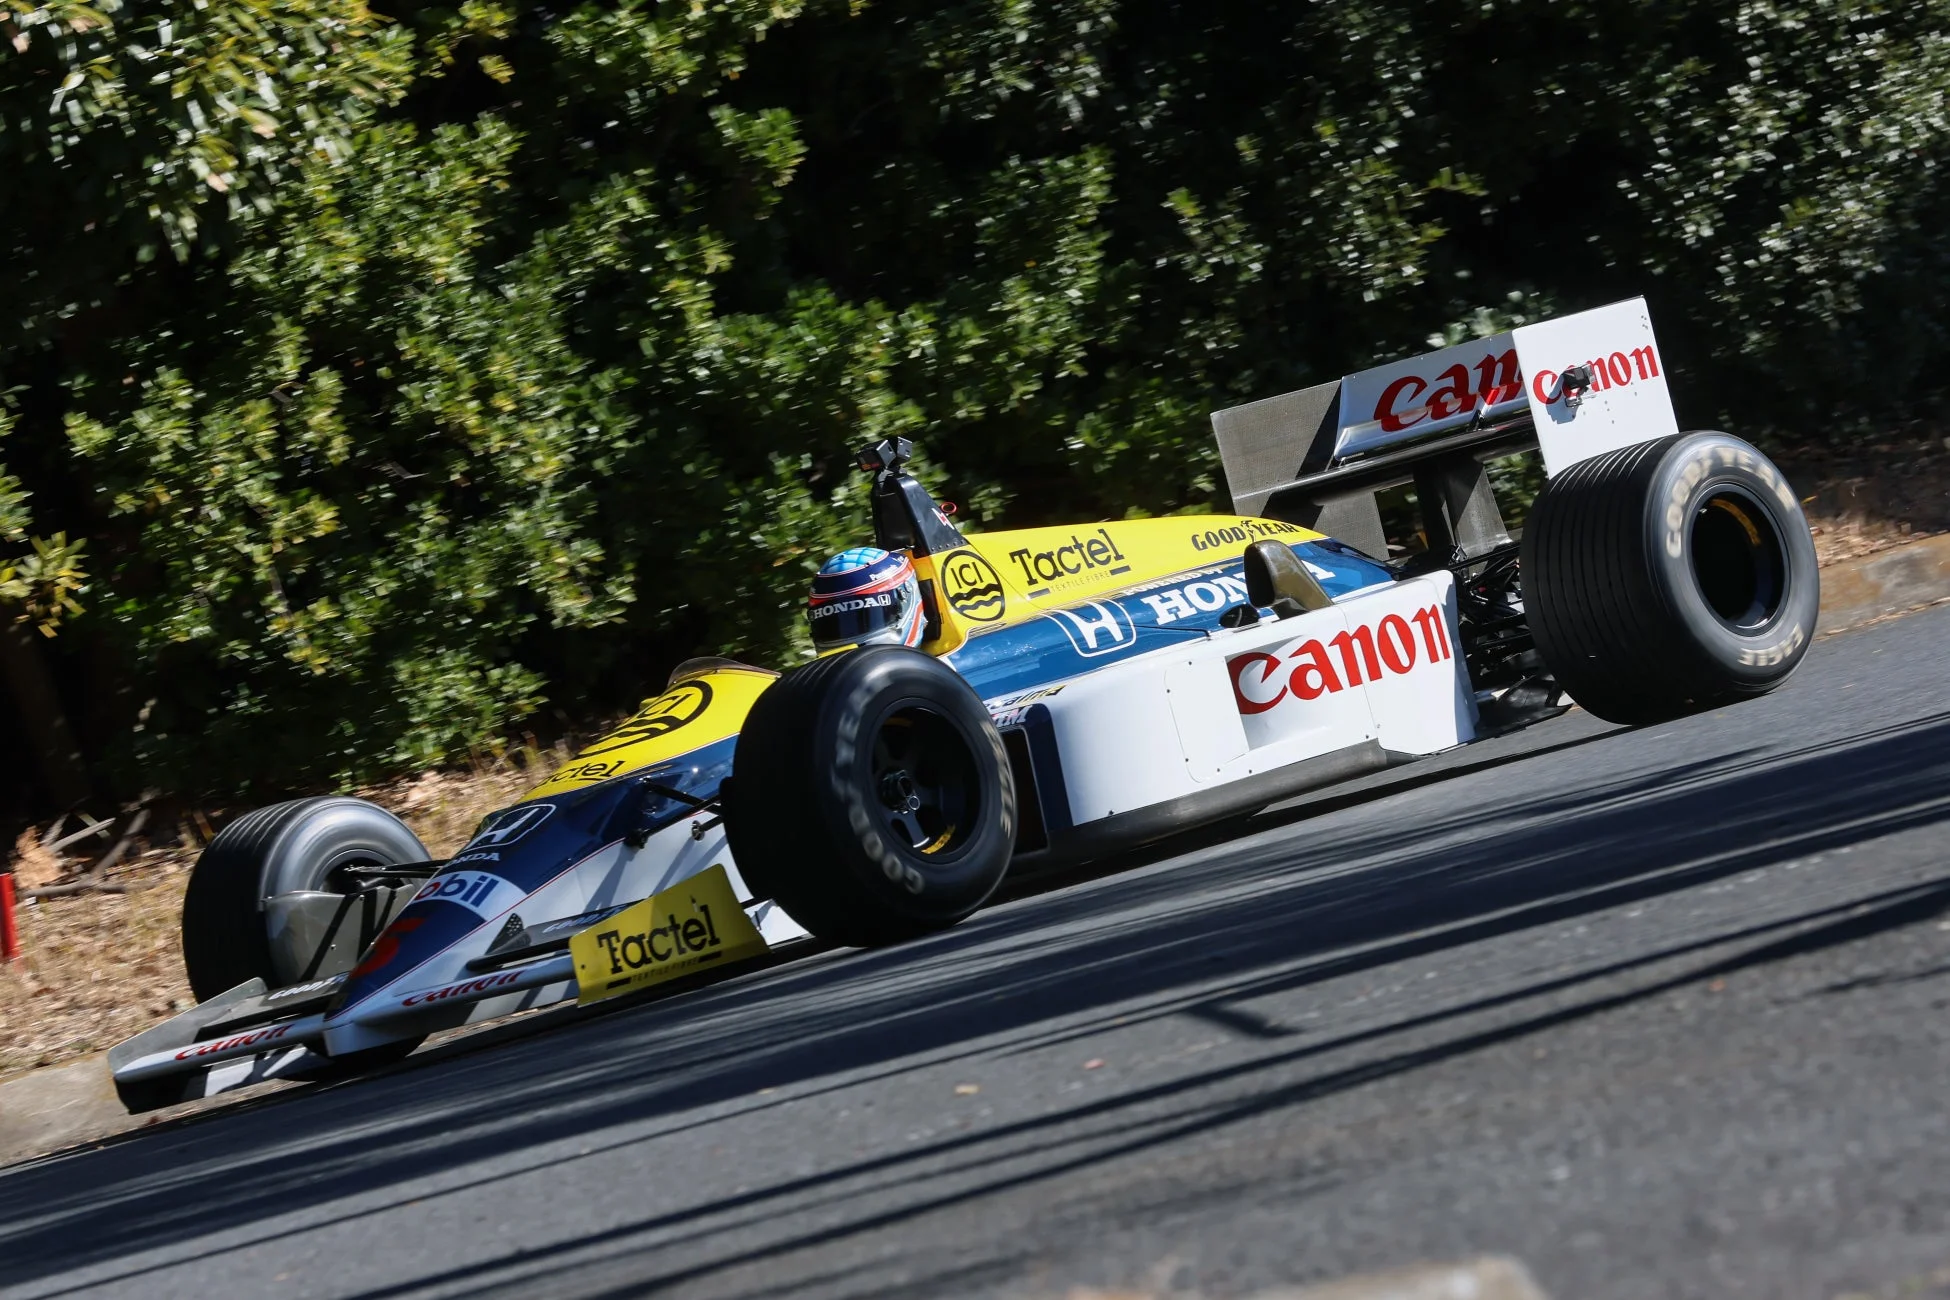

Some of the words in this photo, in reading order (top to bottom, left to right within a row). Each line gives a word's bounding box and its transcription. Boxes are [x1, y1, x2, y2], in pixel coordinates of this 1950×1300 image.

[1373, 348, 1527, 432] Can
[950, 561, 984, 589] ICI
[1009, 528, 1125, 587] Tactel
[813, 597, 880, 619] HONDA
[1140, 560, 1336, 625] HONA
[1226, 603, 1451, 716] Canon
[637, 694, 695, 718] CI
[414, 873, 500, 908] obil
[597, 904, 720, 975] Tactel
[402, 970, 526, 1007] Canon
[174, 1023, 296, 1061] Canon
